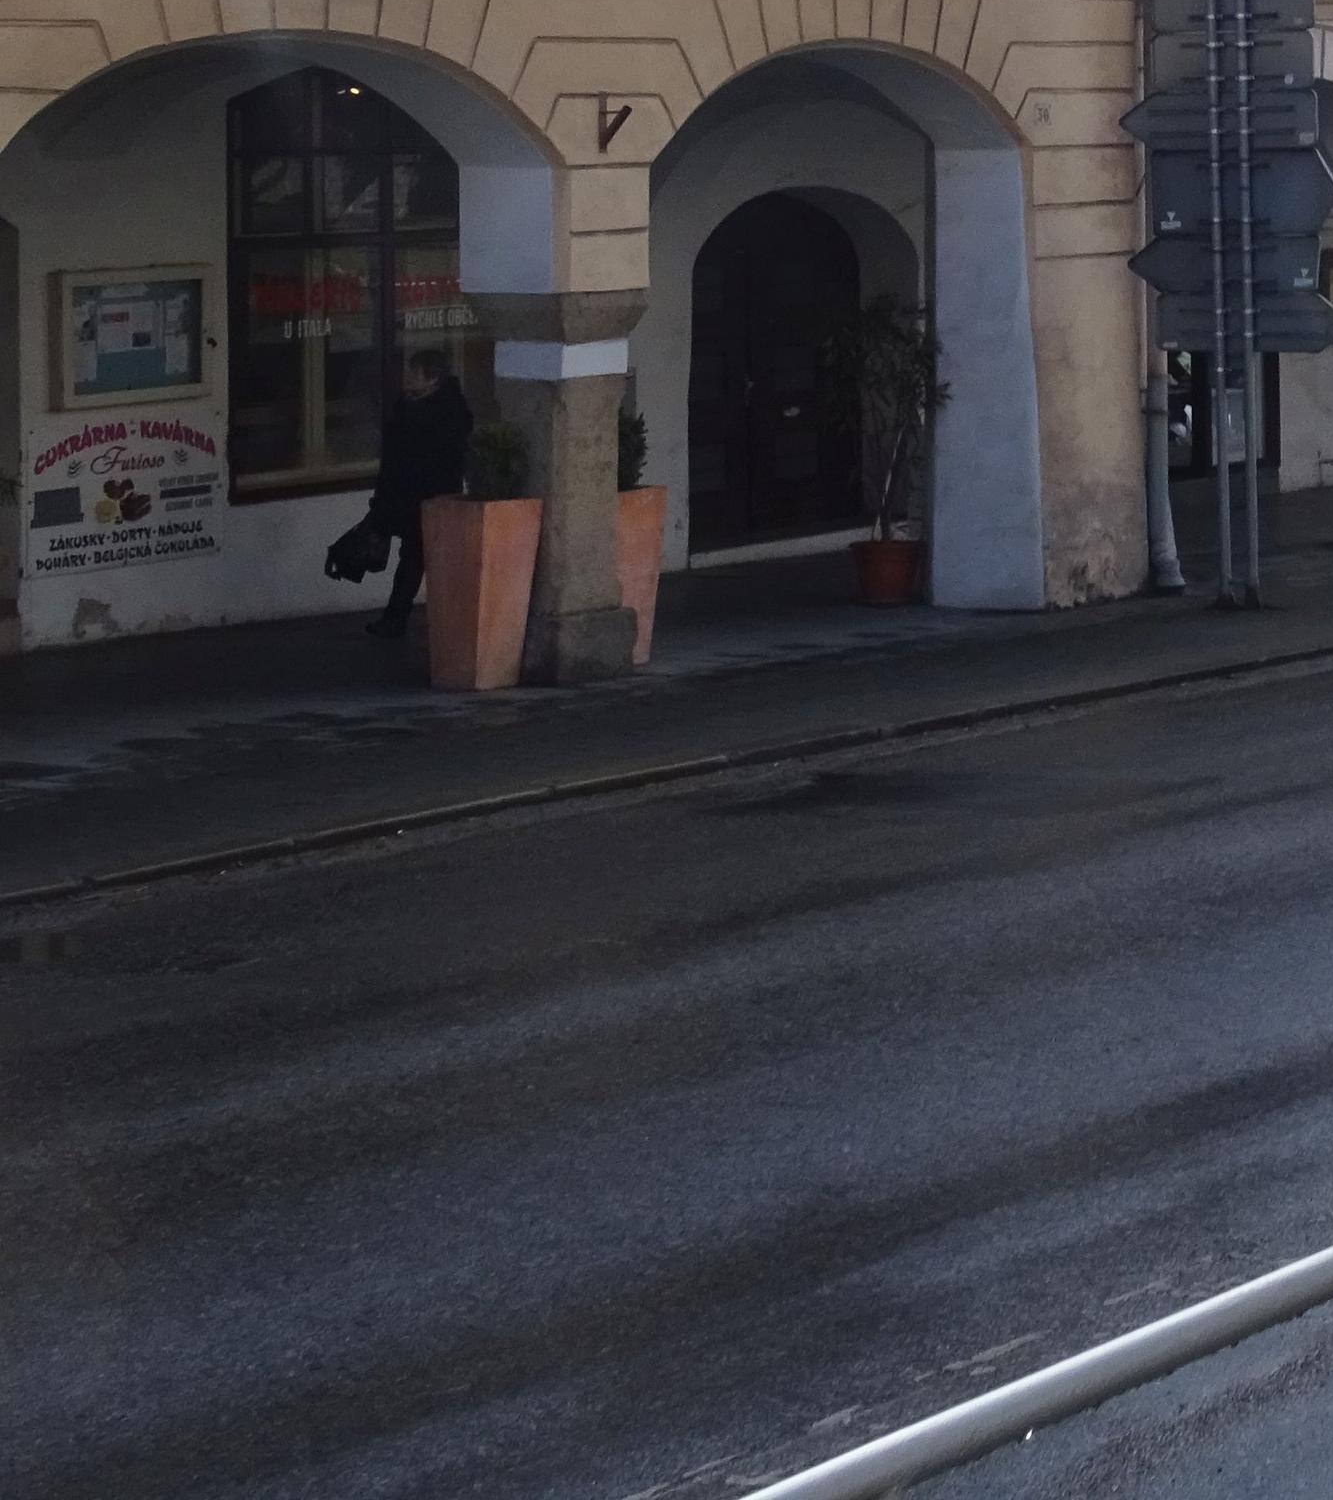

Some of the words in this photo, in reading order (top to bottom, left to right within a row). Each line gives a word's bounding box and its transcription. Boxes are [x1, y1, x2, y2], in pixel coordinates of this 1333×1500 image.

[34, 422, 127, 475] CUKRÁRNA
[140, 419, 216, 457] KAVÁRNA
[49, 534, 105, 552] ZÁKUSKY
[112, 526, 152, 544] DORTY
[155, 534, 215, 555] ČOKOLÁDA
